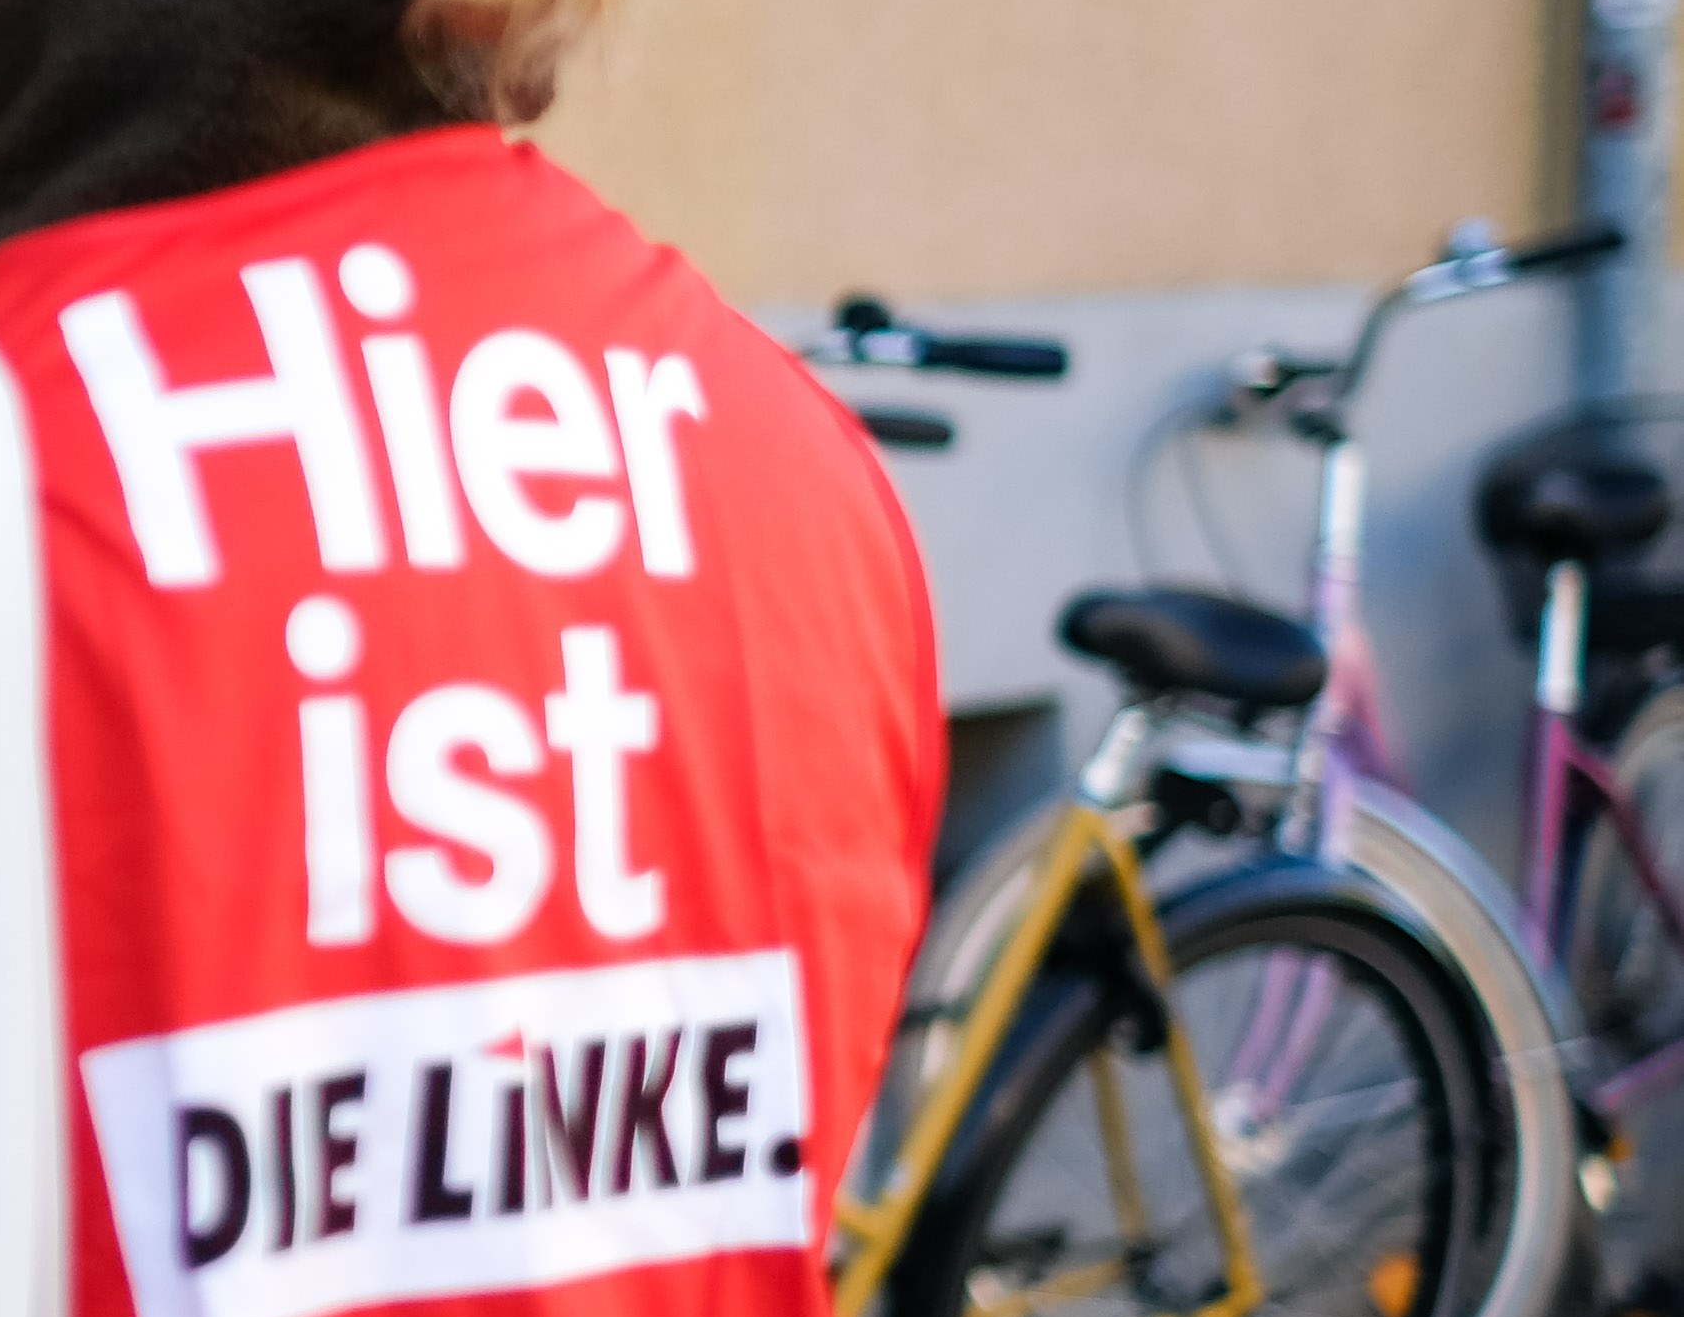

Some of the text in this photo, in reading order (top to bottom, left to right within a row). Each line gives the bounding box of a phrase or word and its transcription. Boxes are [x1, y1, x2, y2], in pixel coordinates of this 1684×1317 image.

[57, 242, 706, 588] Hier
[285, 594, 665, 947] ist
[174, 1019, 803, 1271] DIE LINKE.
